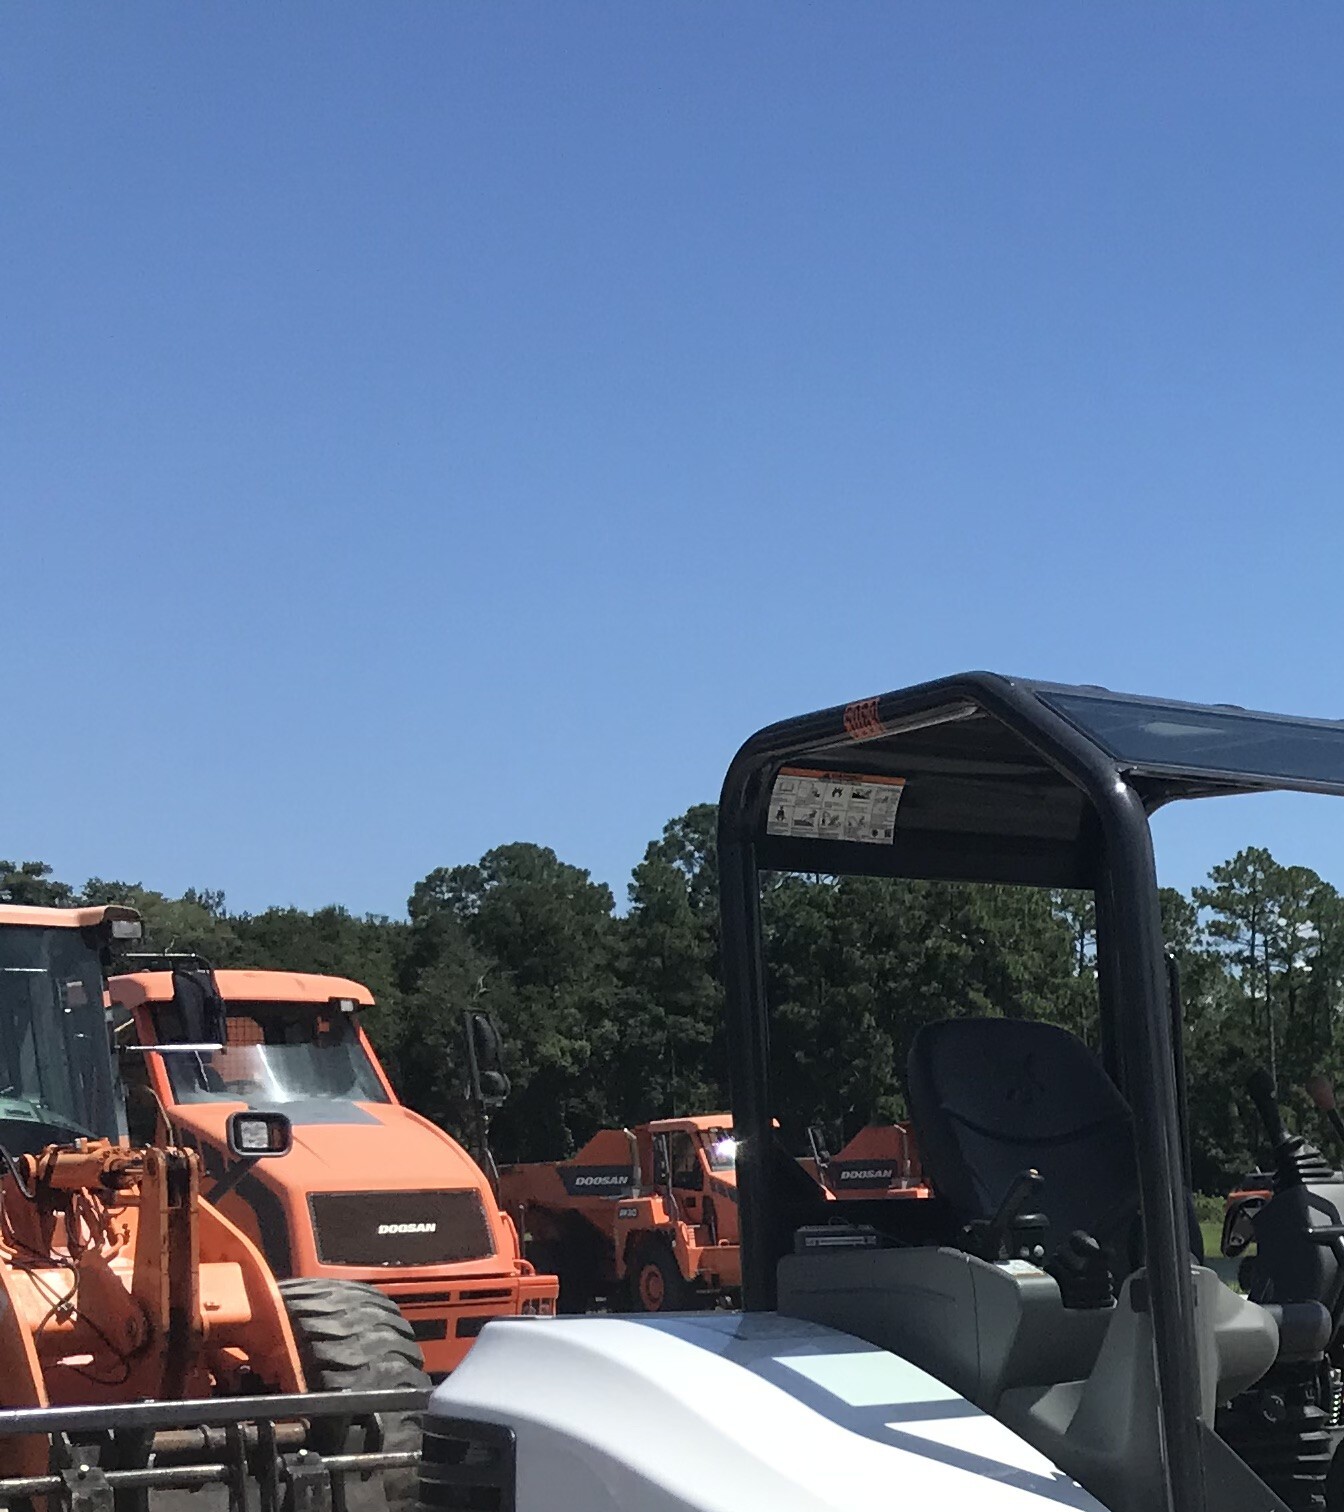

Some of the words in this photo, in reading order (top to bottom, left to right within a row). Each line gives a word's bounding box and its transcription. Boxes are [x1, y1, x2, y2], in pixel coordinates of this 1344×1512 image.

[840, 1169, 893, 1180] DOOSAN
[575, 1176, 629, 1186] DOOSAN
[378, 1223, 437, 1235] DOOSAN
